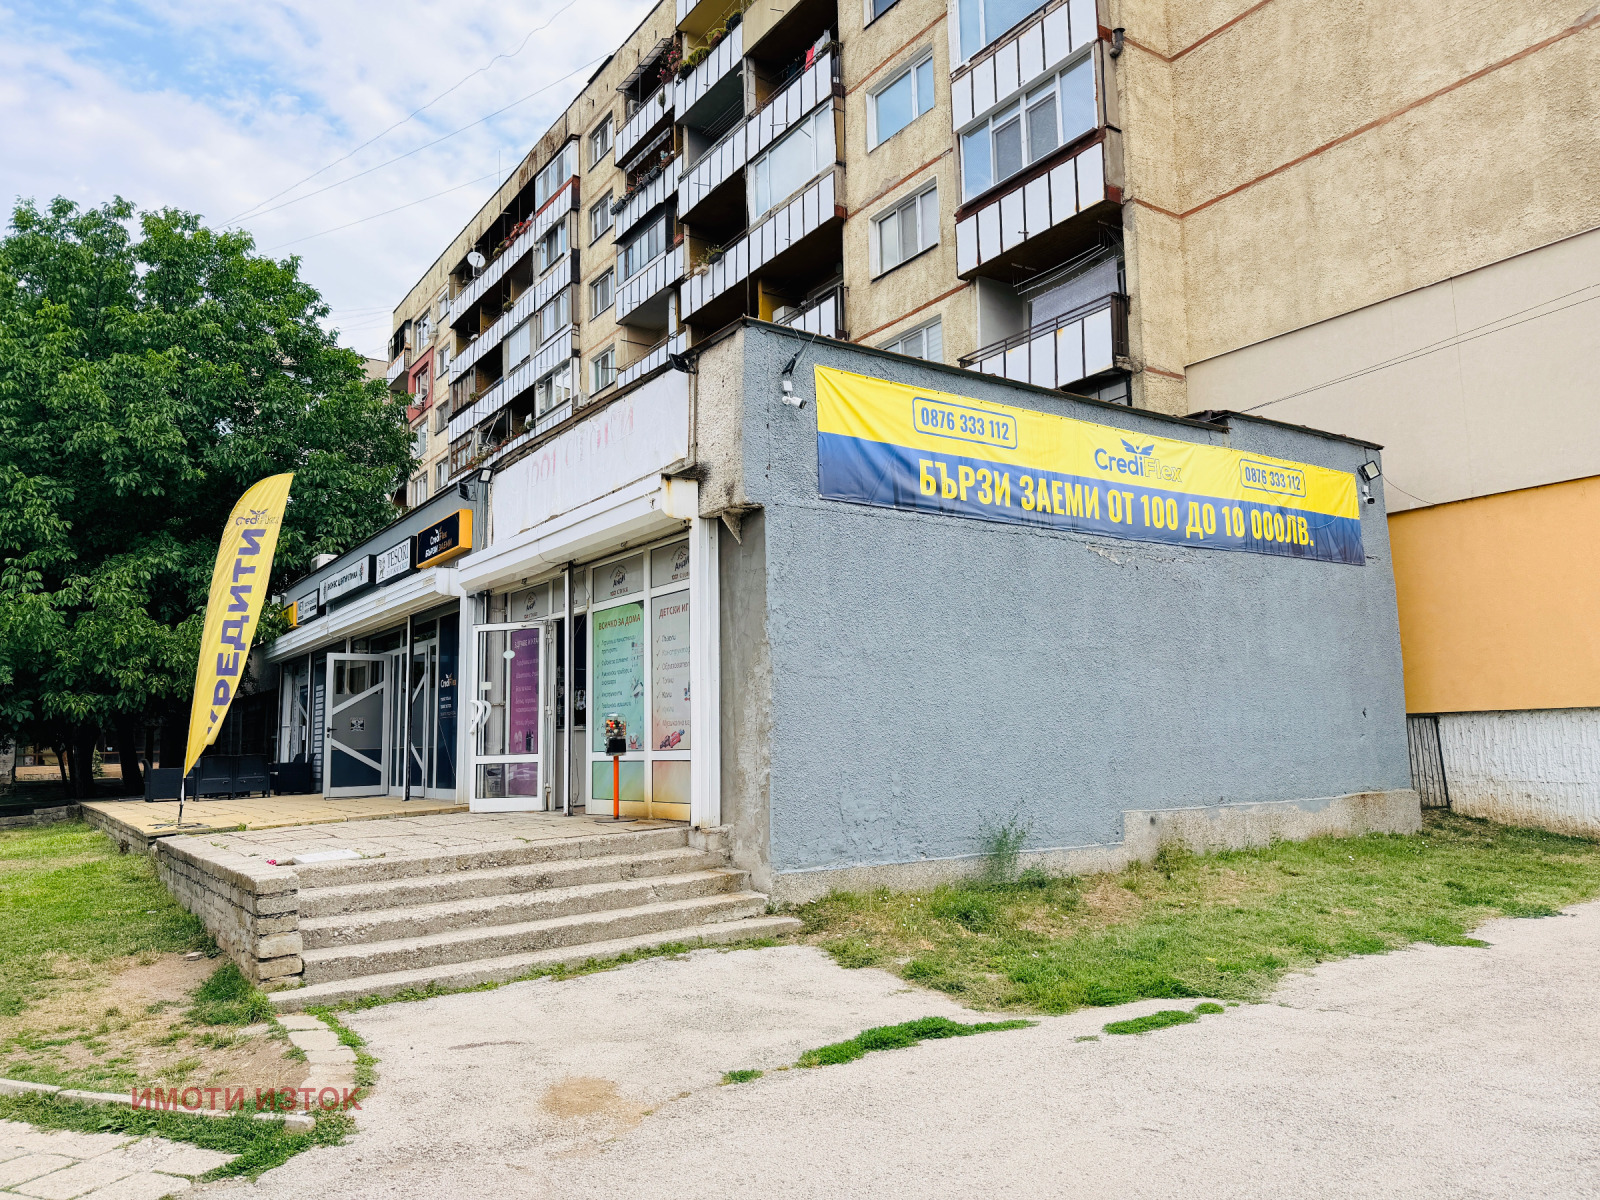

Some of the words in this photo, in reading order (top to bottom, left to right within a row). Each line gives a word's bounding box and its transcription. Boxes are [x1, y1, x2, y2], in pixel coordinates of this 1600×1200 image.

[921, 407, 955, 430] 0876
[960, 414, 985, 436] 333
[989, 420, 1010, 440] 112
[1094, 448, 1183, 483] CrediFlex
[1245, 466, 1267, 485] 0876
[1269, 472, 1286, 489] 333
[1288, 475, 1301, 491] 112
[919, 459, 1011, 507] БЪРЗИ
[1019, 475, 1100, 520] ЗАЕМИ
[1106, 490, 1134, 525] ОТ
[1141, 494, 1178, 531] 100
[1186, 501, 1216, 539] ДО
[1222, 506, 1245, 538] 10
[1251, 509, 1314, 547] 000ЛВ.
[387, 543, 409, 568] TESORI
[598, 619, 617, 630] ВСИЧКО
[618, 618, 625, 627] ЗА
[625, 614, 641, 626] ДОМА
[659, 605, 681, 619] ДЕТСКИ
